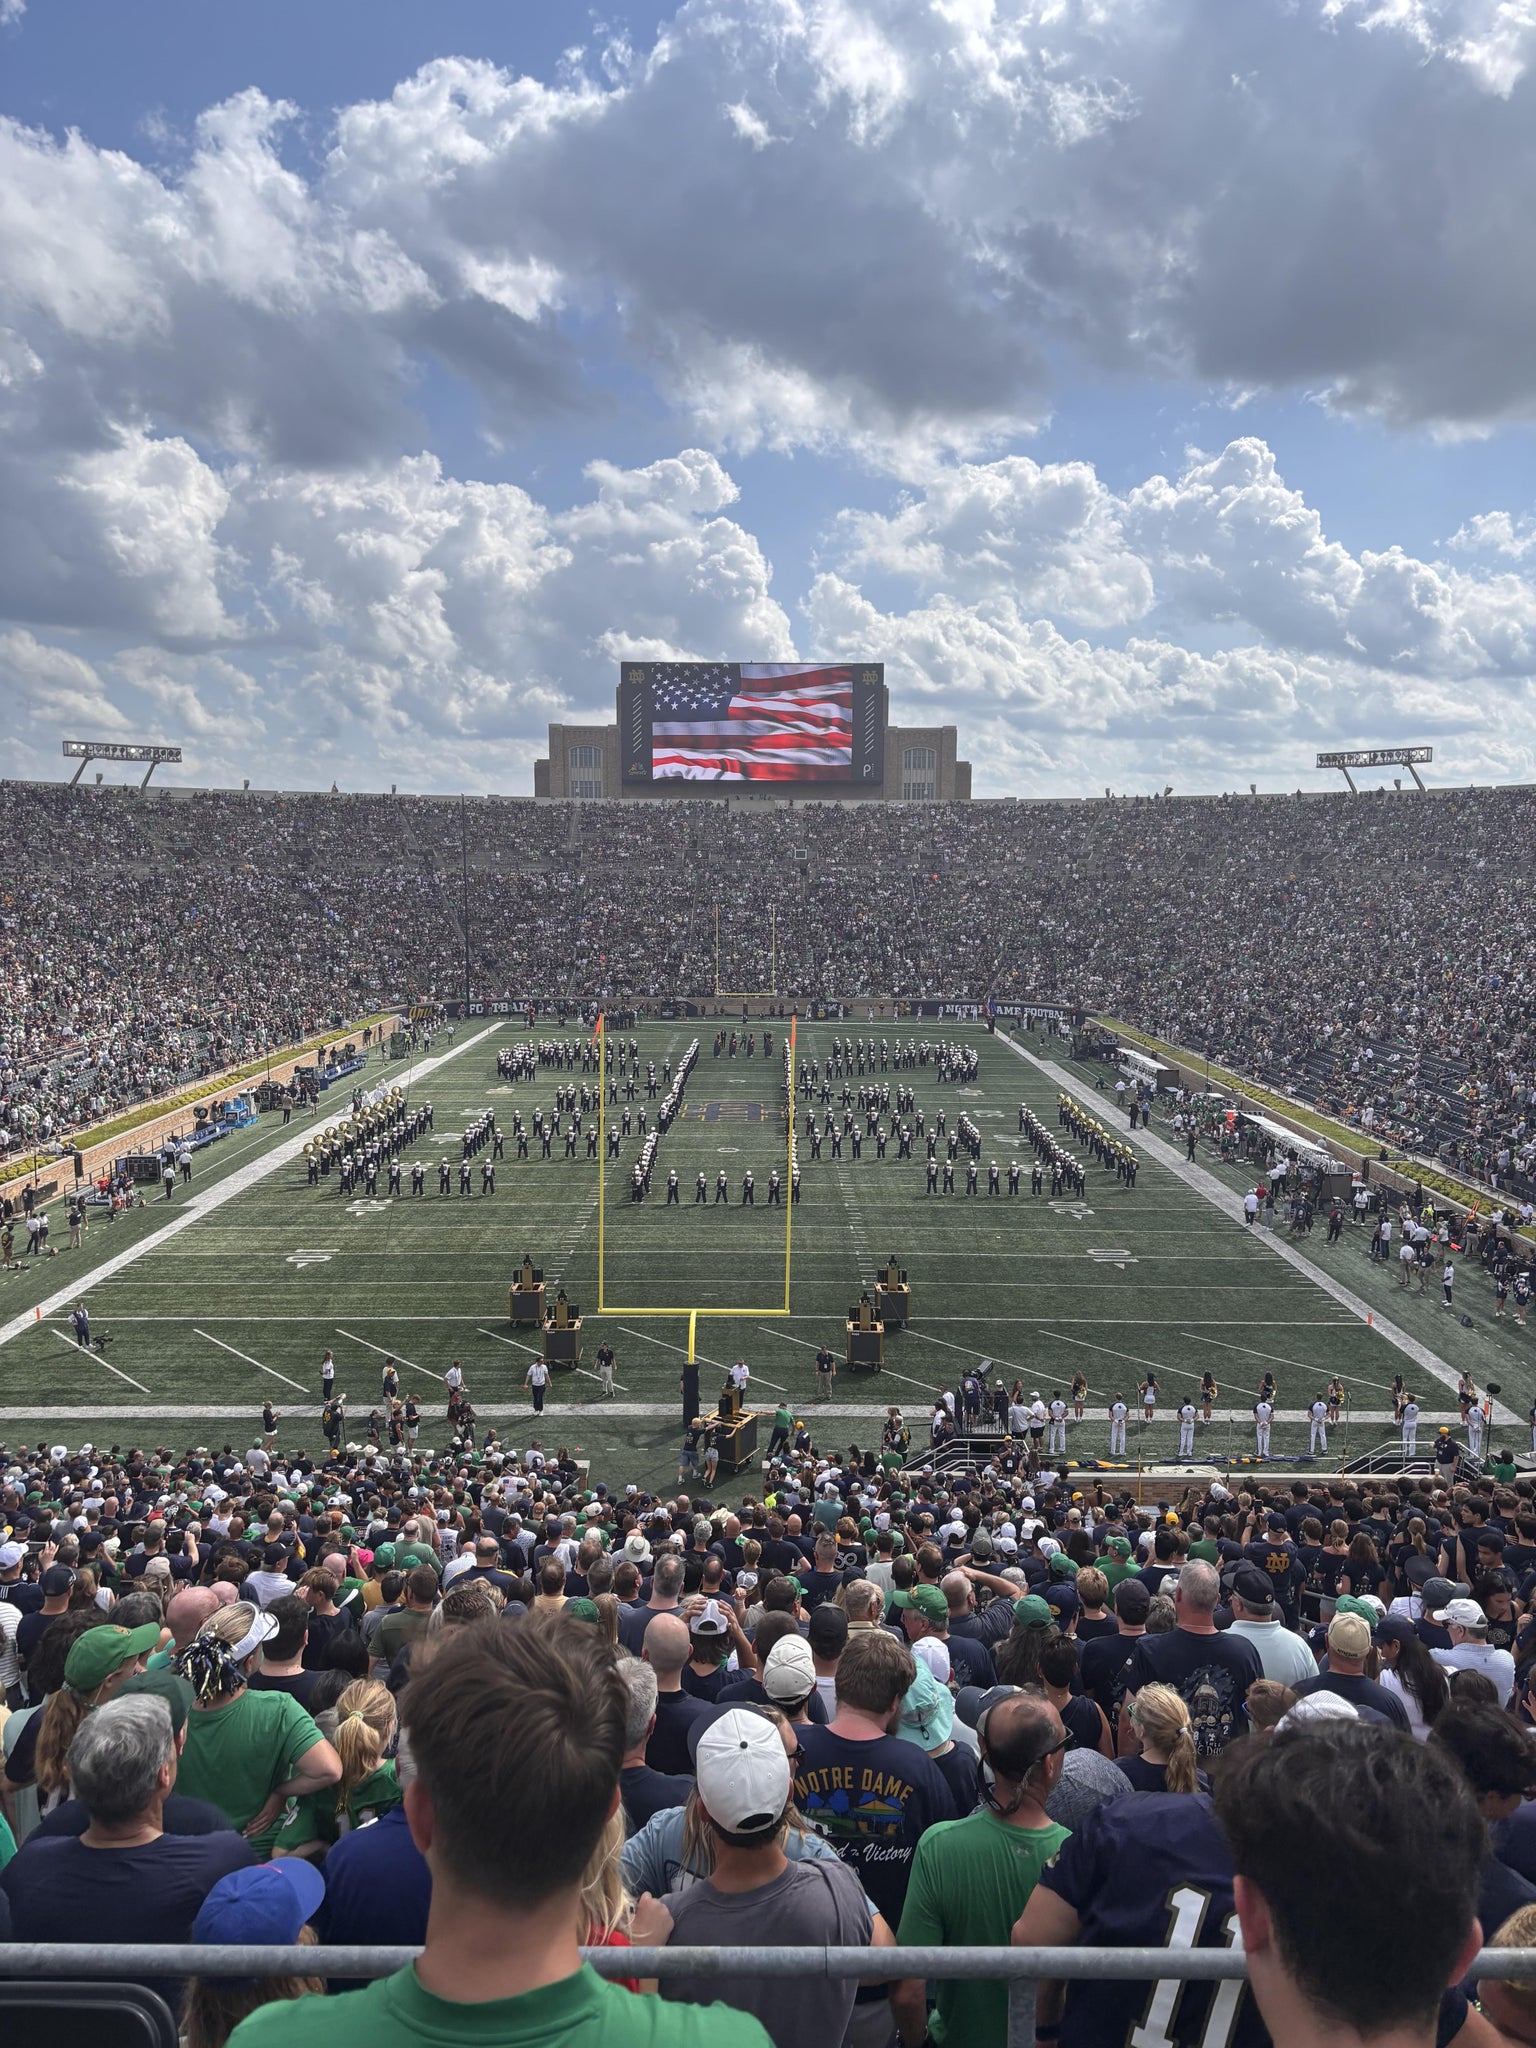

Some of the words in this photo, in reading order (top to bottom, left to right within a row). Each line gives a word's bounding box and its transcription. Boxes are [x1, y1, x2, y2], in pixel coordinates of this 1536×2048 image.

[469, 1001, 526, 1014] FOTBAL
[1023, 1007, 1064, 1019] FOOTBAL
[1265, 1551, 1290, 1573] ND
[794, 1766, 855, 1800] NOTRE
[861, 1768, 914, 1806] DAME
[862, 1842, 912, 1863] Victory
